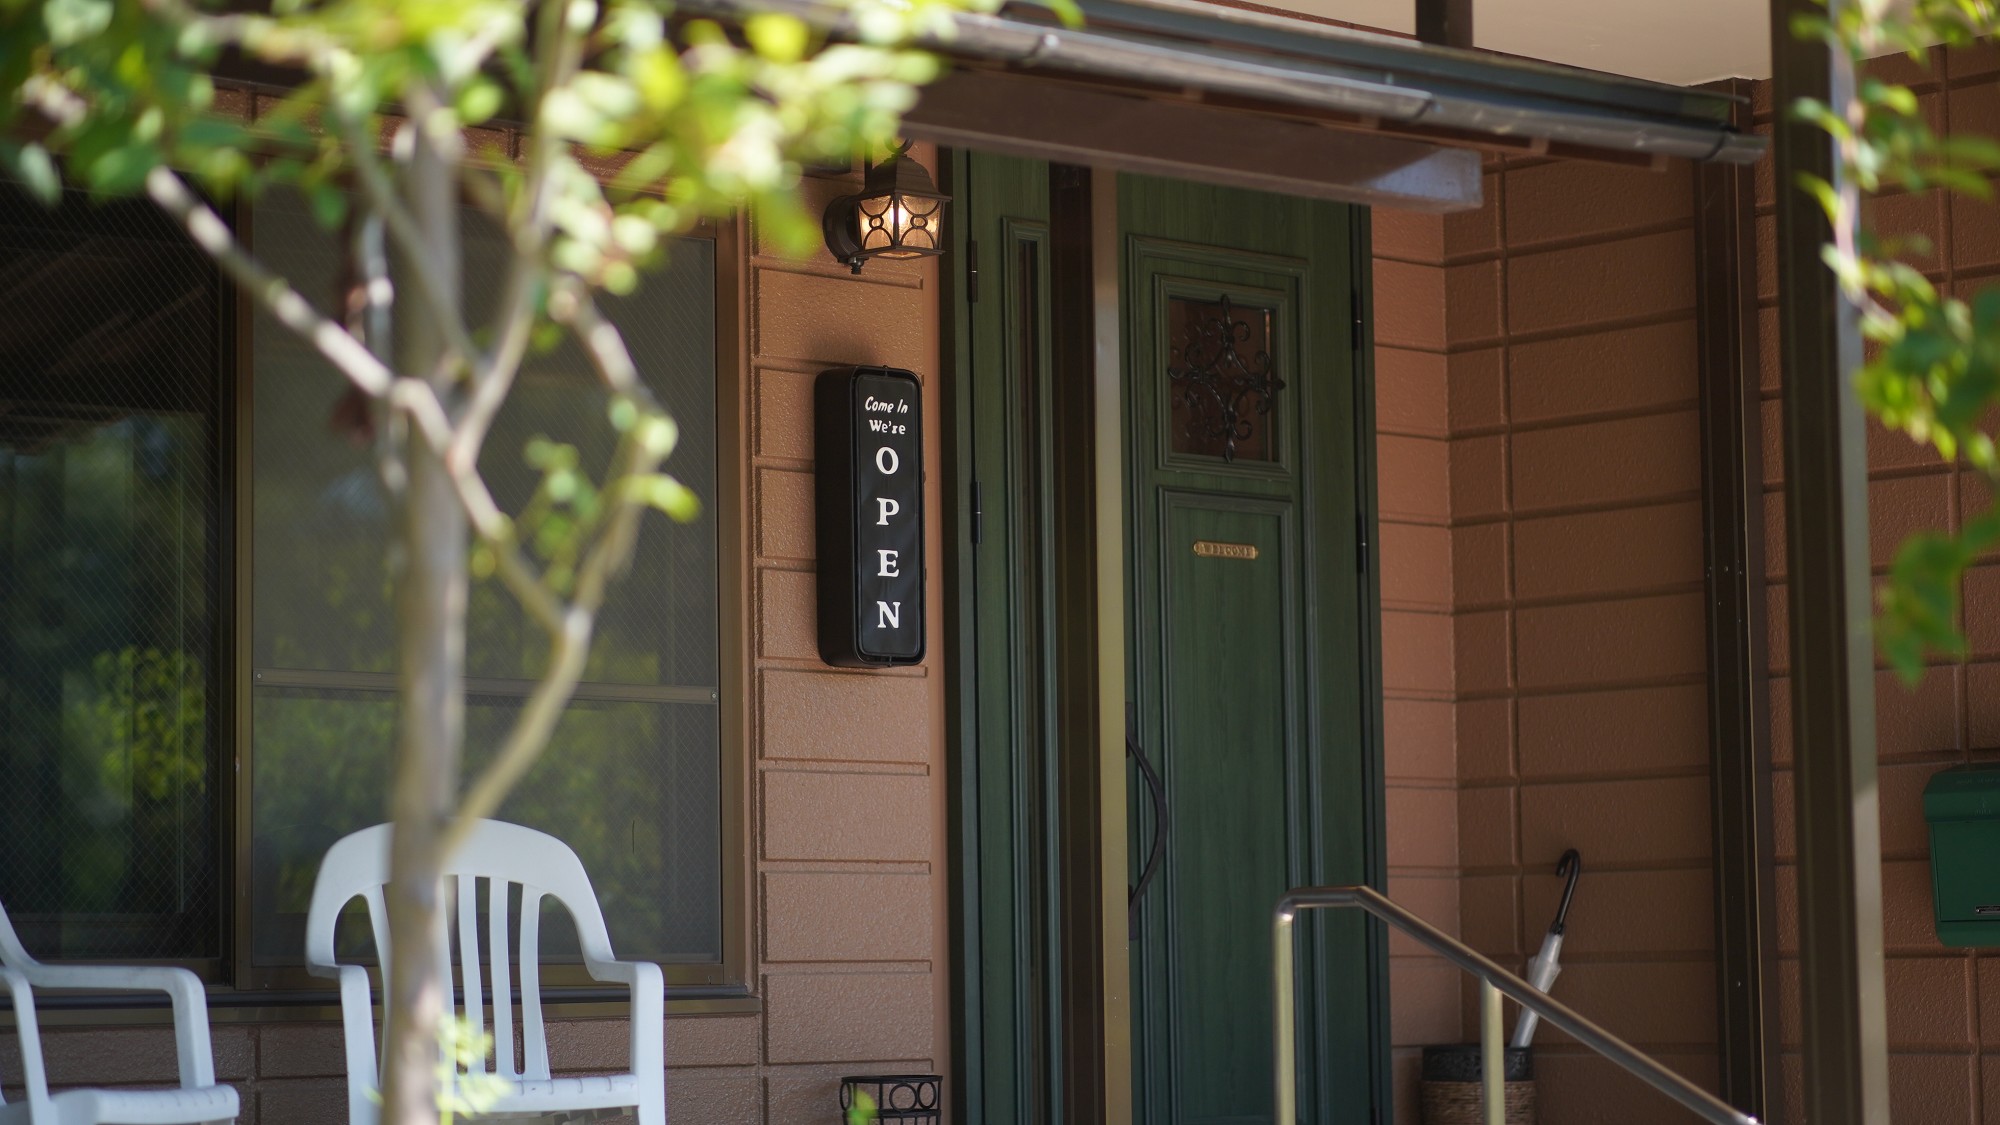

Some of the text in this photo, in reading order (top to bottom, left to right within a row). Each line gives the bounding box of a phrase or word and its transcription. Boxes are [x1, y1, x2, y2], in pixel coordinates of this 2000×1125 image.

[864, 395, 908, 414] Come In
[868, 419, 906, 435] We're
[875, 446, 901, 629] OPEN
[1200, 542, 1252, 557] WELCOME
